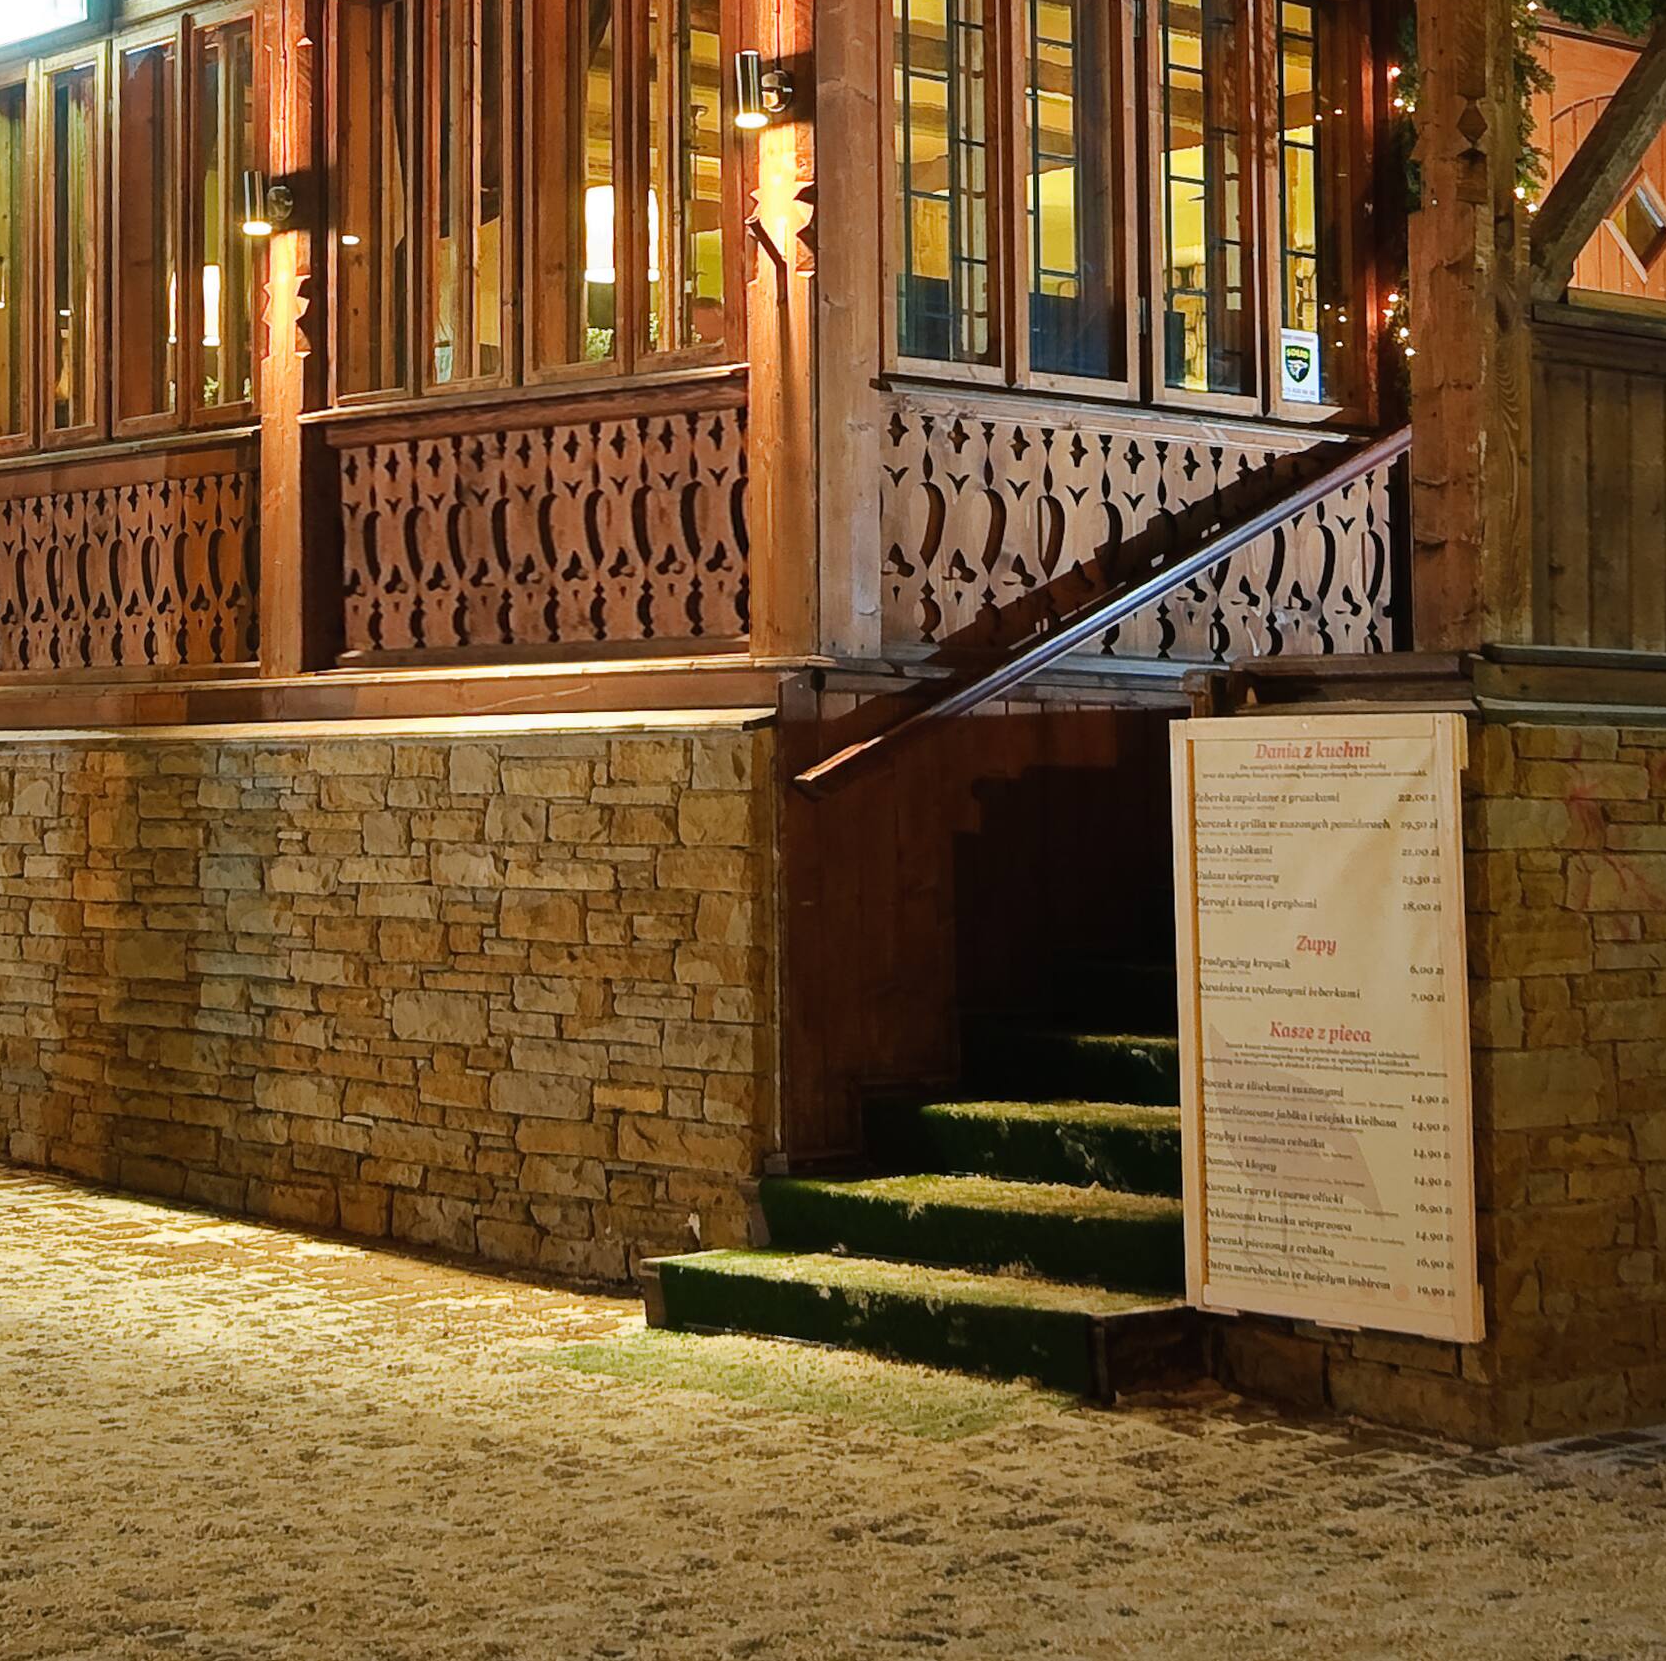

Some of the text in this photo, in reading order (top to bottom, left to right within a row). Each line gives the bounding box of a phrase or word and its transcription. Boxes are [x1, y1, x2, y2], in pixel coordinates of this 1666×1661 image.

[1256, 741, 1371, 759] Dania z kuchni
[1296, 935, 1337, 956] Zupy
[1270, 1021, 1371, 1044] Kasze z pieca
